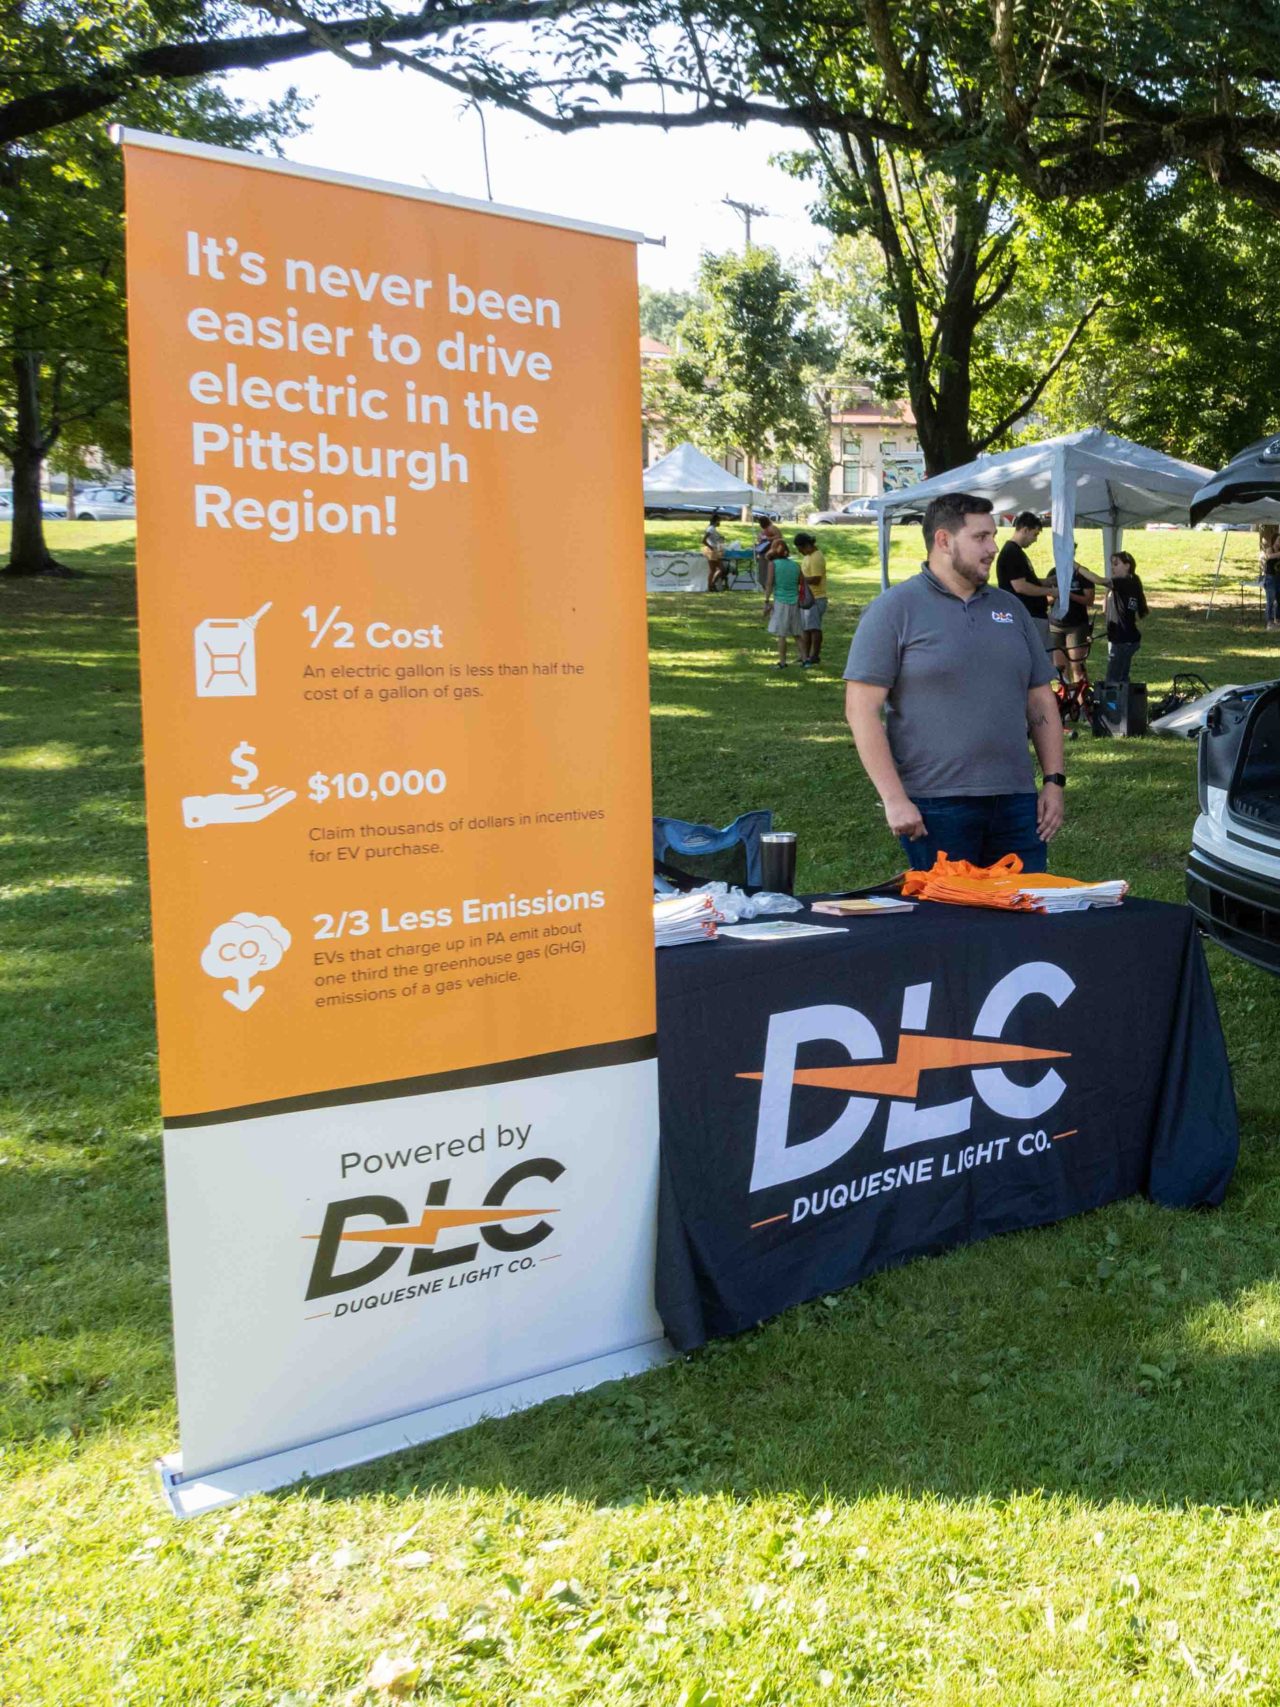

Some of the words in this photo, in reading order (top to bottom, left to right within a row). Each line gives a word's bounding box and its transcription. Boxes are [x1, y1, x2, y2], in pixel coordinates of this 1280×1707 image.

[186, 231, 267, 286] It’s
[286, 258, 432, 309] never
[448, 274, 561, 329] been
[187, 307, 354, 356] easier
[368, 323, 422, 366] to
[437, 332, 553, 381] drive
[189, 363, 388, 421] electric
[406, 381, 449, 425] in
[464, 393, 539, 435] the
[192, 422, 469, 491] Pittsburgh
[194, 484, 398, 542] Region!
[366, 621, 444, 649] Cost
[303, 664, 326, 678] An
[331, 664, 391, 678] electric
[396, 664, 445, 680] gallon
[449, 663, 462, 678] is
[466, 663, 494, 677] less
[497, 662, 528, 676] than
[532, 662, 560, 676] half
[562, 662, 584, 675] the
[303, 686, 338, 701] cost
[343, 685, 360, 700] of
[363, 688, 374, 699] a
[378, 685, 428, 702] gallon
[433, 684, 450, 698] of
[453, 686, 484, 702] gas.
[307, 769, 447, 803] $10,000
[309, 826, 355, 842] Claim
[360, 819, 444, 838] thousands
[448, 817, 464, 832] of
[468, 814, 515, 830] dollars
[519, 812, 532, 826] in
[535, 808, 605, 825] incentives
[309, 847, 332, 862] for
[336, 846, 360, 861] EV
[365, 842, 444, 861] purchase.
[313, 910, 370, 941] 2/3
[381, 906, 453, 932] Less
[462, 888, 605, 925] Emissions
[314, 950, 345, 966] EVs
[349, 946, 382, 963] that
[386, 940, 441, 960] charge
[445, 940, 465, 954] up
[469, 934, 483, 948] in
[486, 931, 505, 946] PA
[509, 927, 539, 943] emit
[542, 922, 582, 938] about
[314, 973, 346, 987] one
[351, 965, 388, 982] third
[393, 961, 419, 977] the
[423, 950, 513, 976] greenhouse
[516, 947, 541, 964] gas
[544, 939, 586, 959] (GHG)
[315, 986, 397, 1008] emissions
[401, 982, 417, 998] of
[421, 983, 432, 995] a
[436, 977, 462, 996] gas
[467, 970, 521, 988] vehicle.
[749, 961, 1077, 1193] DLC
[341, 1128, 485, 1178] Powered
[497, 1124, 532, 1150] by
[791, 1157, 934, 1223] DUQUESNE
[941, 1137, 1010, 1177] LIGHT
[1017, 1130, 1051, 1157] CO.
[304, 1157, 566, 1301] DLC
[334, 1279, 444, 1317] DUQUESNE
[448, 1264, 503, 1289] LIGHT
[507, 1257, 537, 1273] CO.
